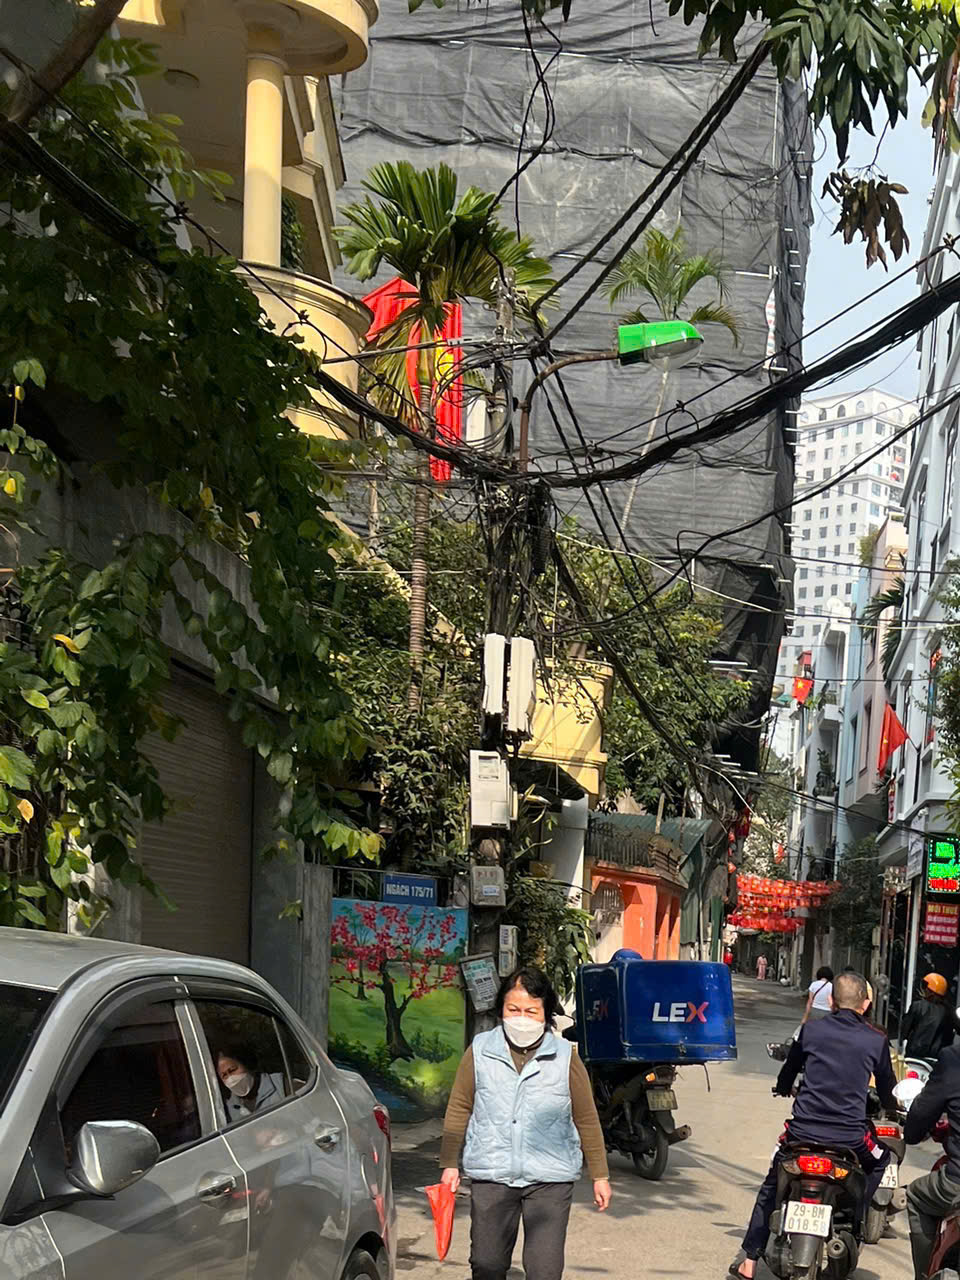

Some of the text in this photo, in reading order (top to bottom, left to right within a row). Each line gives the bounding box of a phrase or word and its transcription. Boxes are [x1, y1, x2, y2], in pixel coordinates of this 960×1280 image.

[386, 882, 433, 898] NGÁCH 175/71
[652, 1001, 709, 1022] LEX
[793, 1203, 826, 1220] 29-BM
